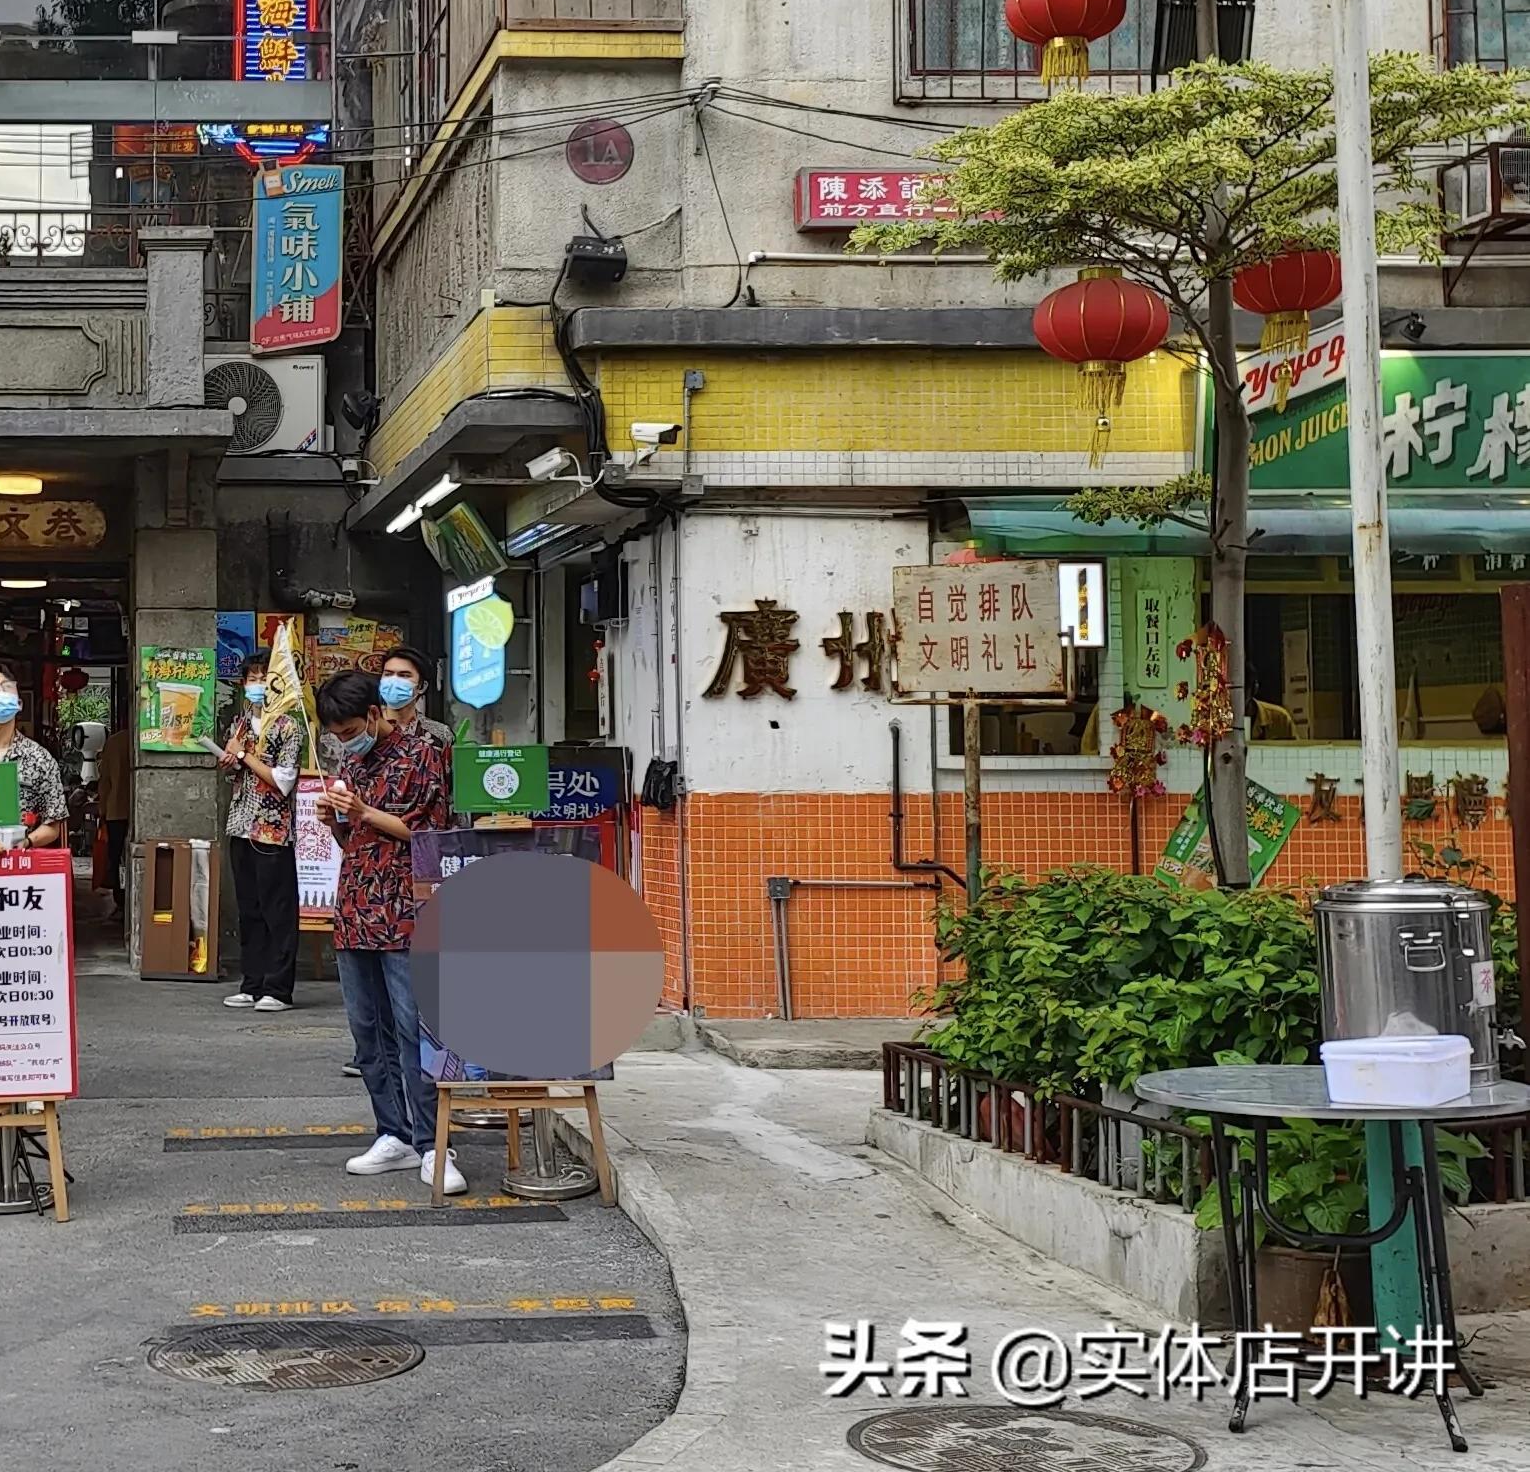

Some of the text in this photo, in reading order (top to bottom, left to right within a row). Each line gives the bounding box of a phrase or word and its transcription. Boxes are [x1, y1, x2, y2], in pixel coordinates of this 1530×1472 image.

[283, 171, 337, 194] Smell
[818, 176, 945, 201] 陳添記
[1248, 426, 1293, 469] MON
[917, 583, 1035, 624] 自觉排队
[702, 596, 898, 701] 廣州
[919, 632, 1037, 673] 文明礼让
[1144, 597, 1160, 679] 取餐口左转
[548, 770, 600, 799] 号处
